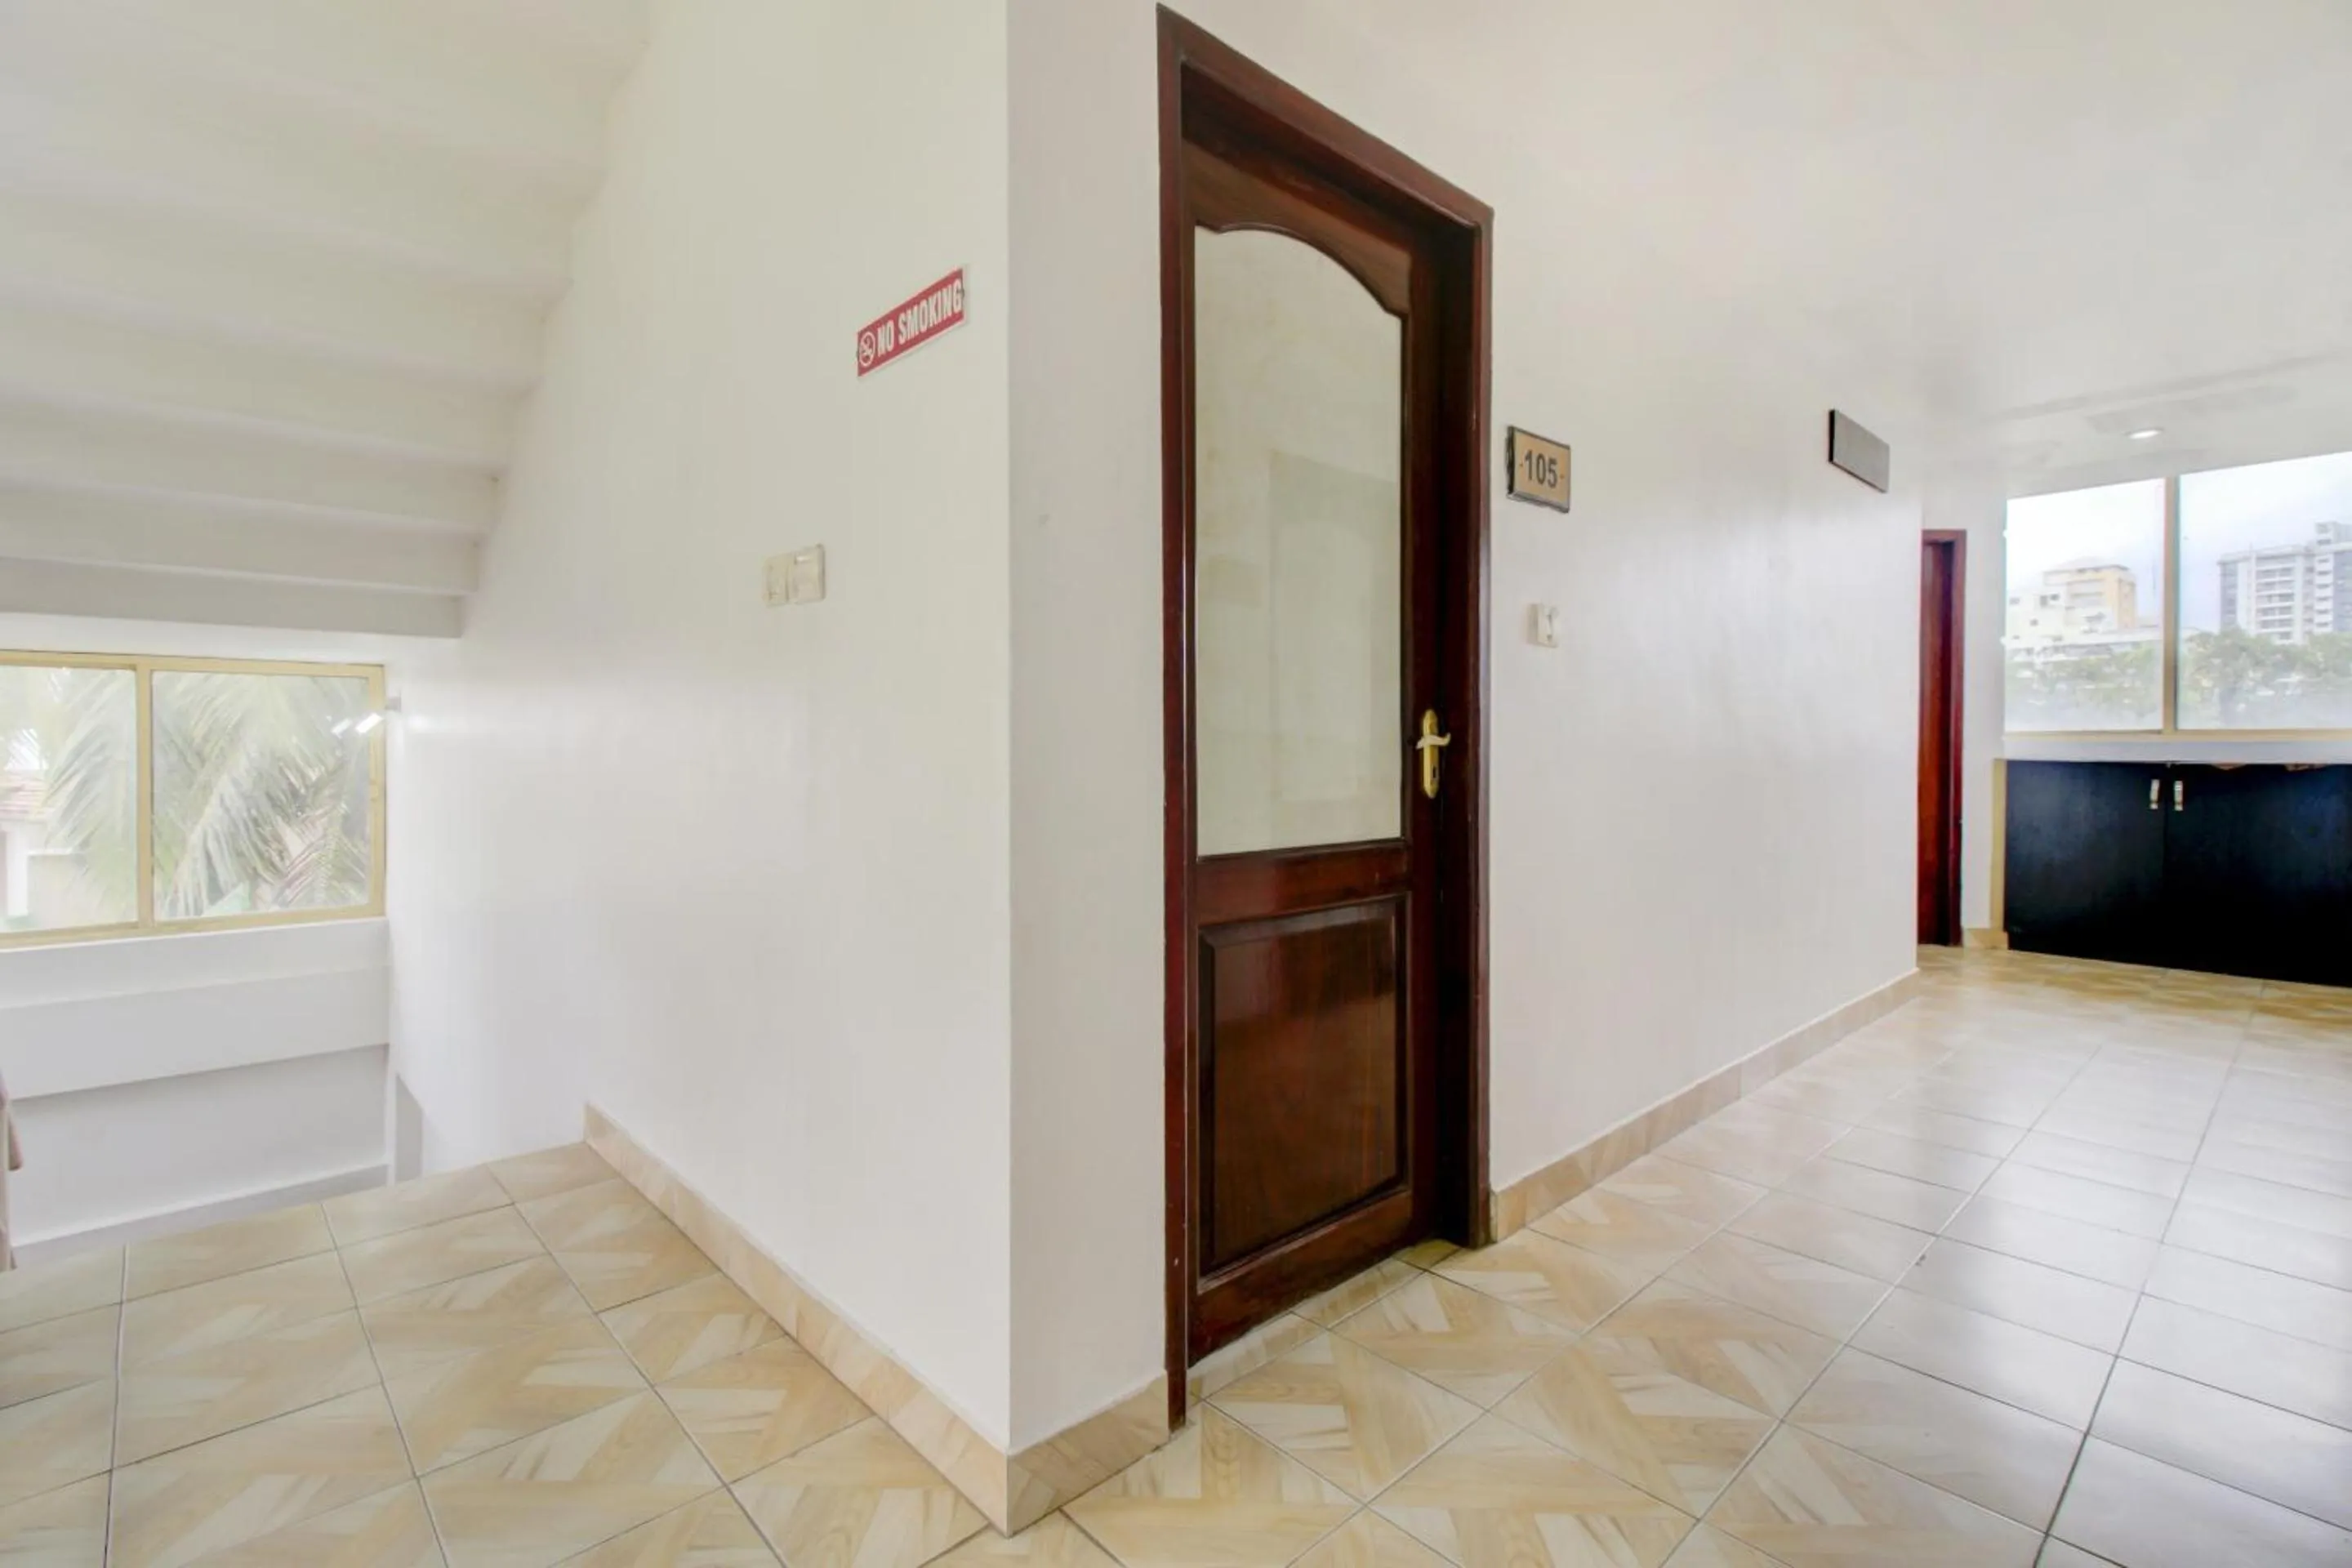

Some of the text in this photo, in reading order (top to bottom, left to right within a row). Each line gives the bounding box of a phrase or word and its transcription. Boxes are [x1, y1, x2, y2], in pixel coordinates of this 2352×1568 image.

[877, 278, 962, 357] NO SMOKING
[1525, 449, 1558, 488] 105
